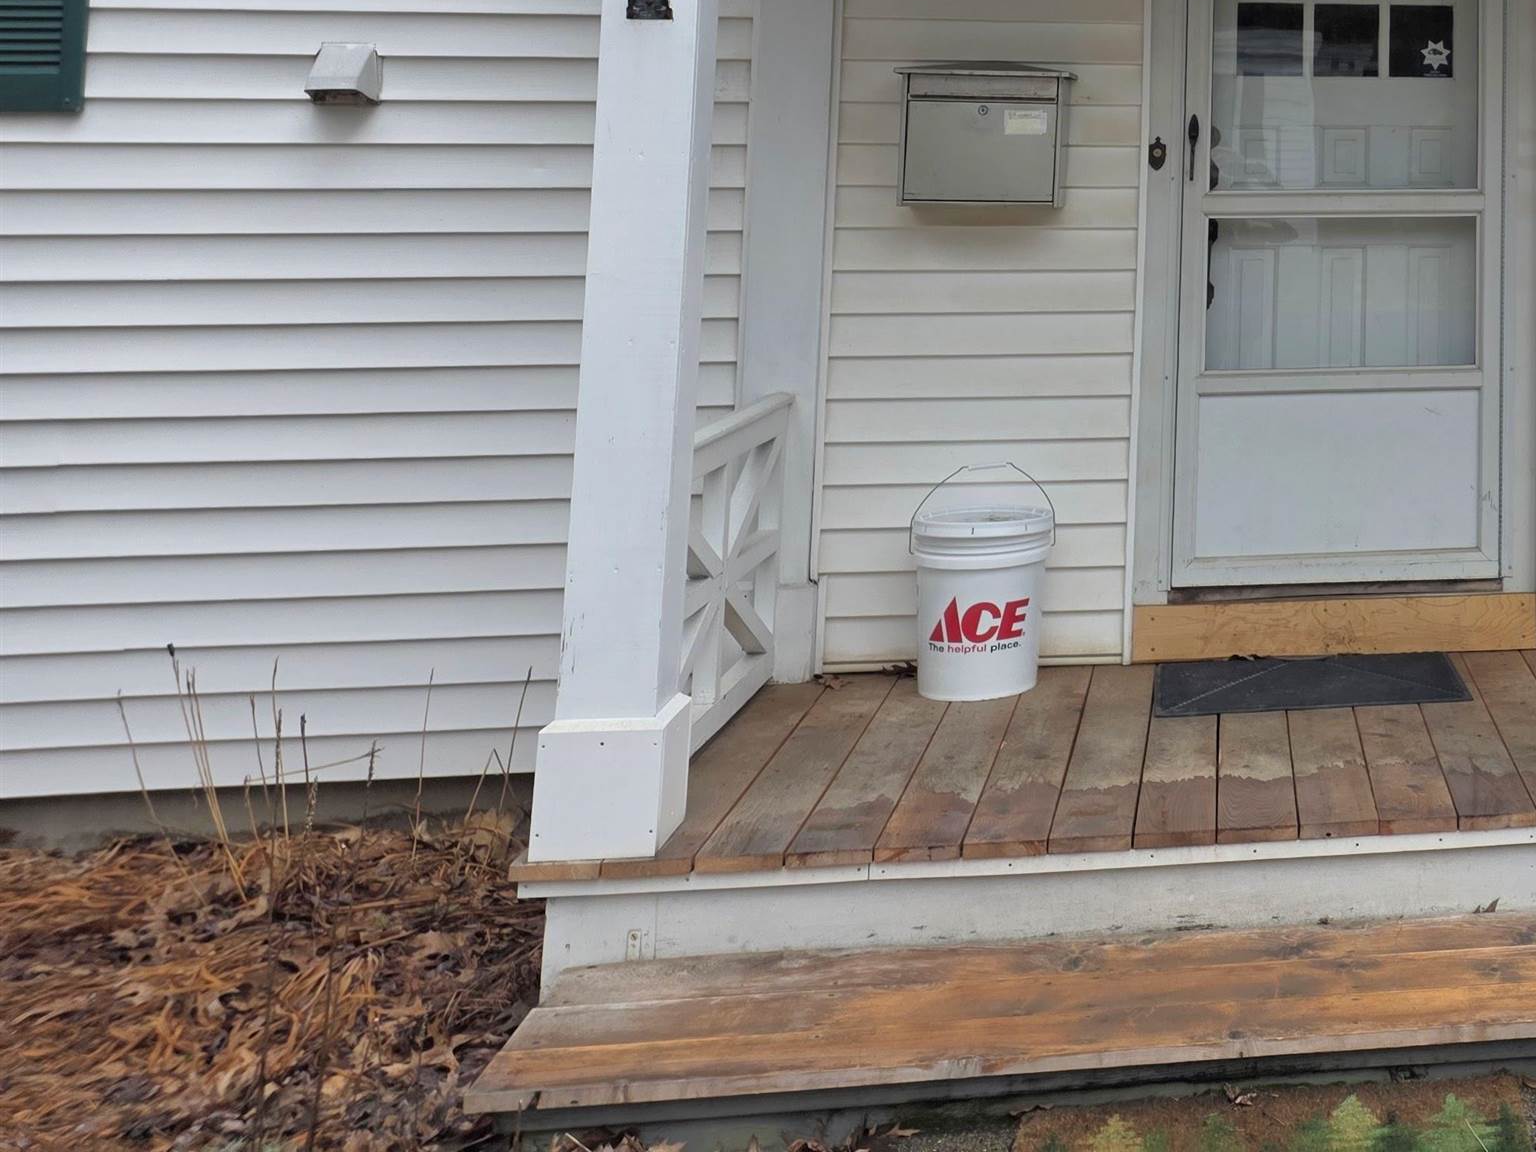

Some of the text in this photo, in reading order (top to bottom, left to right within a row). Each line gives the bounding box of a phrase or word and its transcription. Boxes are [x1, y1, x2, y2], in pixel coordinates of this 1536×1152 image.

[929, 596, 1030, 643] ACE
[929, 642, 945, 653] The
[947, 644, 987, 655] helpful
